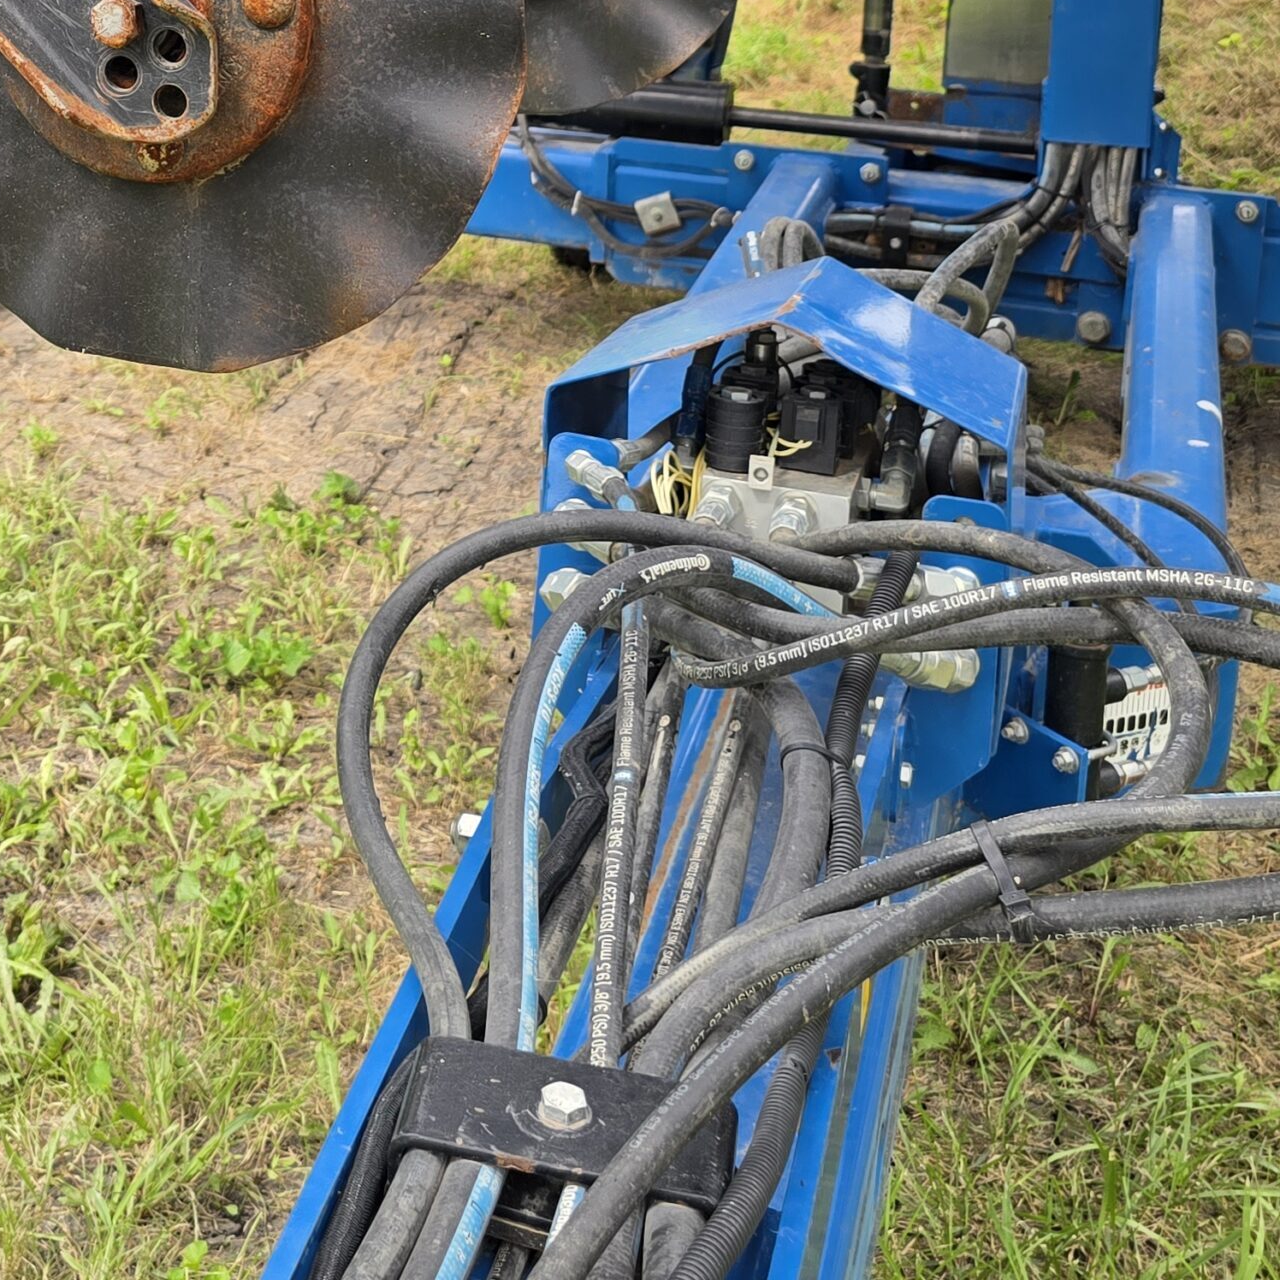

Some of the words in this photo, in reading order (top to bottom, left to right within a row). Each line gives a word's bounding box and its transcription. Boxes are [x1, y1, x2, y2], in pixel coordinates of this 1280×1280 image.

[872, 611, 899, 631] R17
[911, 600, 940, 619] SAE
[941, 586, 996, 611] 100R17
[1023, 574, 1069, 592] Flame
[1071, 568, 1143, 585] Resistant
[1146, 568, 1191, 584] MSHA
[1194, 571, 1255, 593] 2G-11C
[623, 629, 639, 663] 2G-11C
[623, 665, 637, 691] MSHA
[619, 691, 635, 735] Resistant
[617, 736, 632, 767] Flame
[610, 785, 628, 825] 100R17
[609, 827, 624, 848] SAE
[605, 856, 621, 879] R17
[598, 934, 617, 961] mm)
[592, 1014, 610, 1037] PSI)
[627, 1114, 662, 1150] GATES
